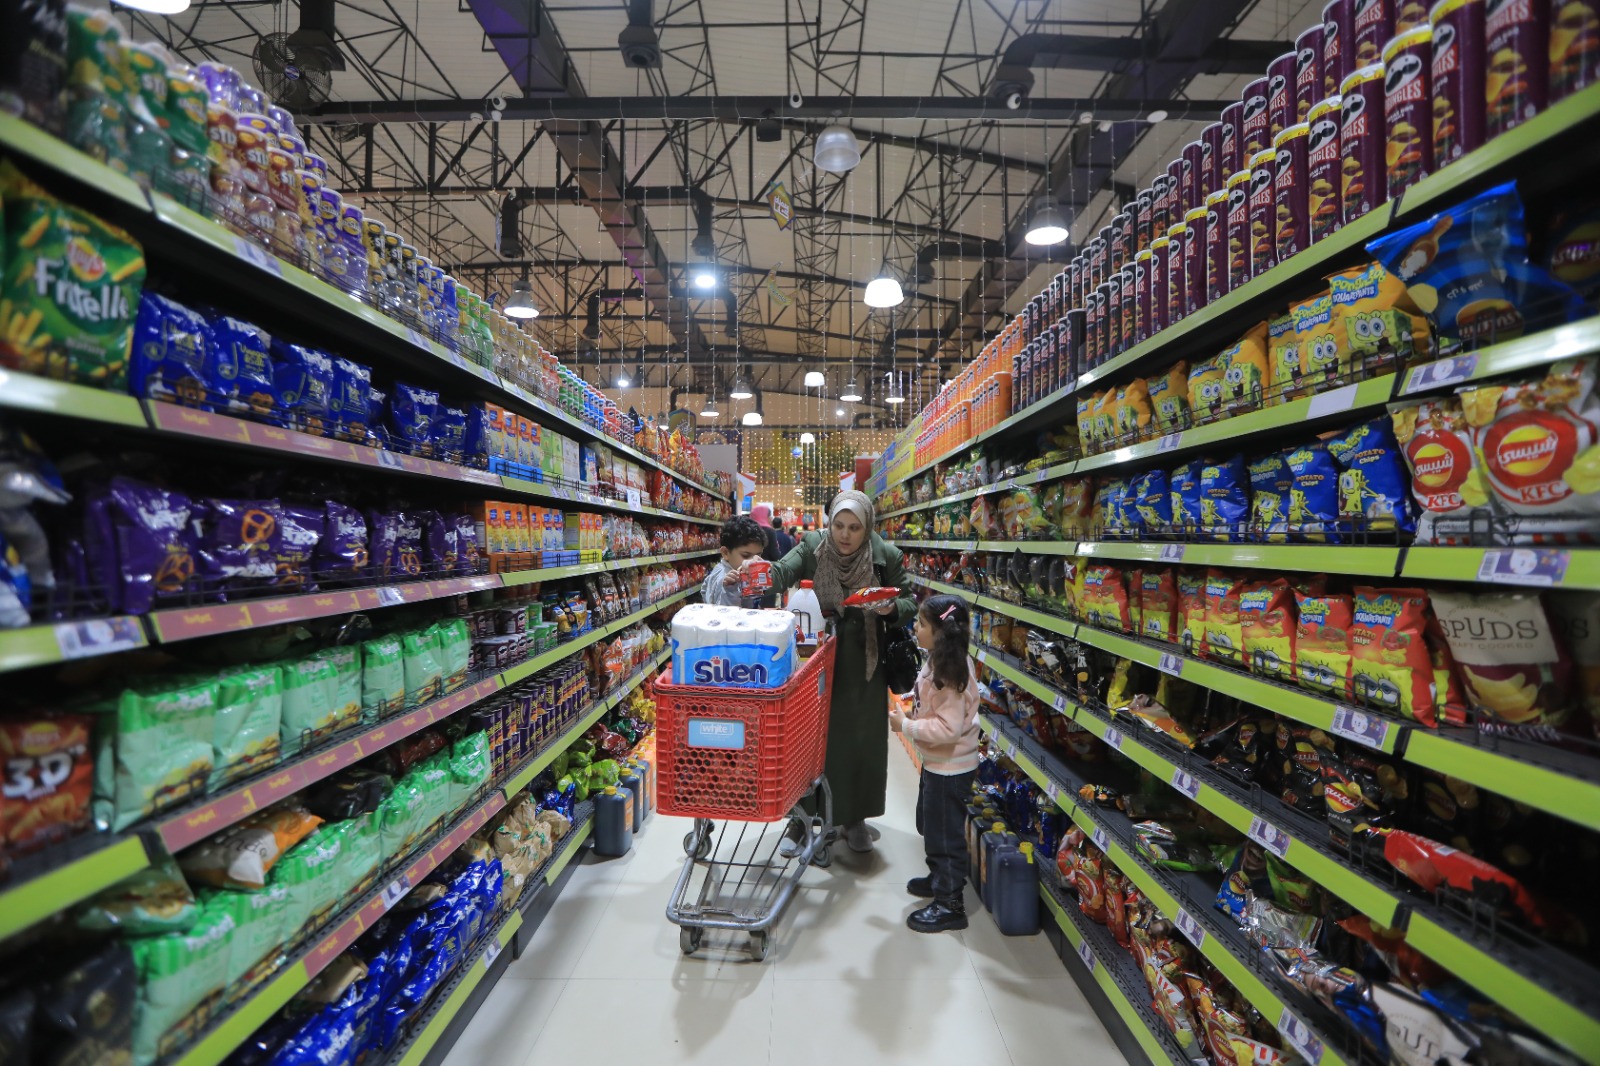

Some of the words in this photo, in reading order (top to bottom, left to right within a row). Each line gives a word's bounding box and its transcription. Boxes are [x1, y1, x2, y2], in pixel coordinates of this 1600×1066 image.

[1498, 432, 1559, 465] شيبسي
[1414, 452, 1454, 477] شيبسي
[1427, 493, 1461, 509] KFC
[1519, 481, 1565, 504] KFC
[1438, 616, 1539, 640] SPUDS
[694, 656, 768, 684] Silen
[702, 724, 728, 735] white
[3, 751, 73, 797] 3D
